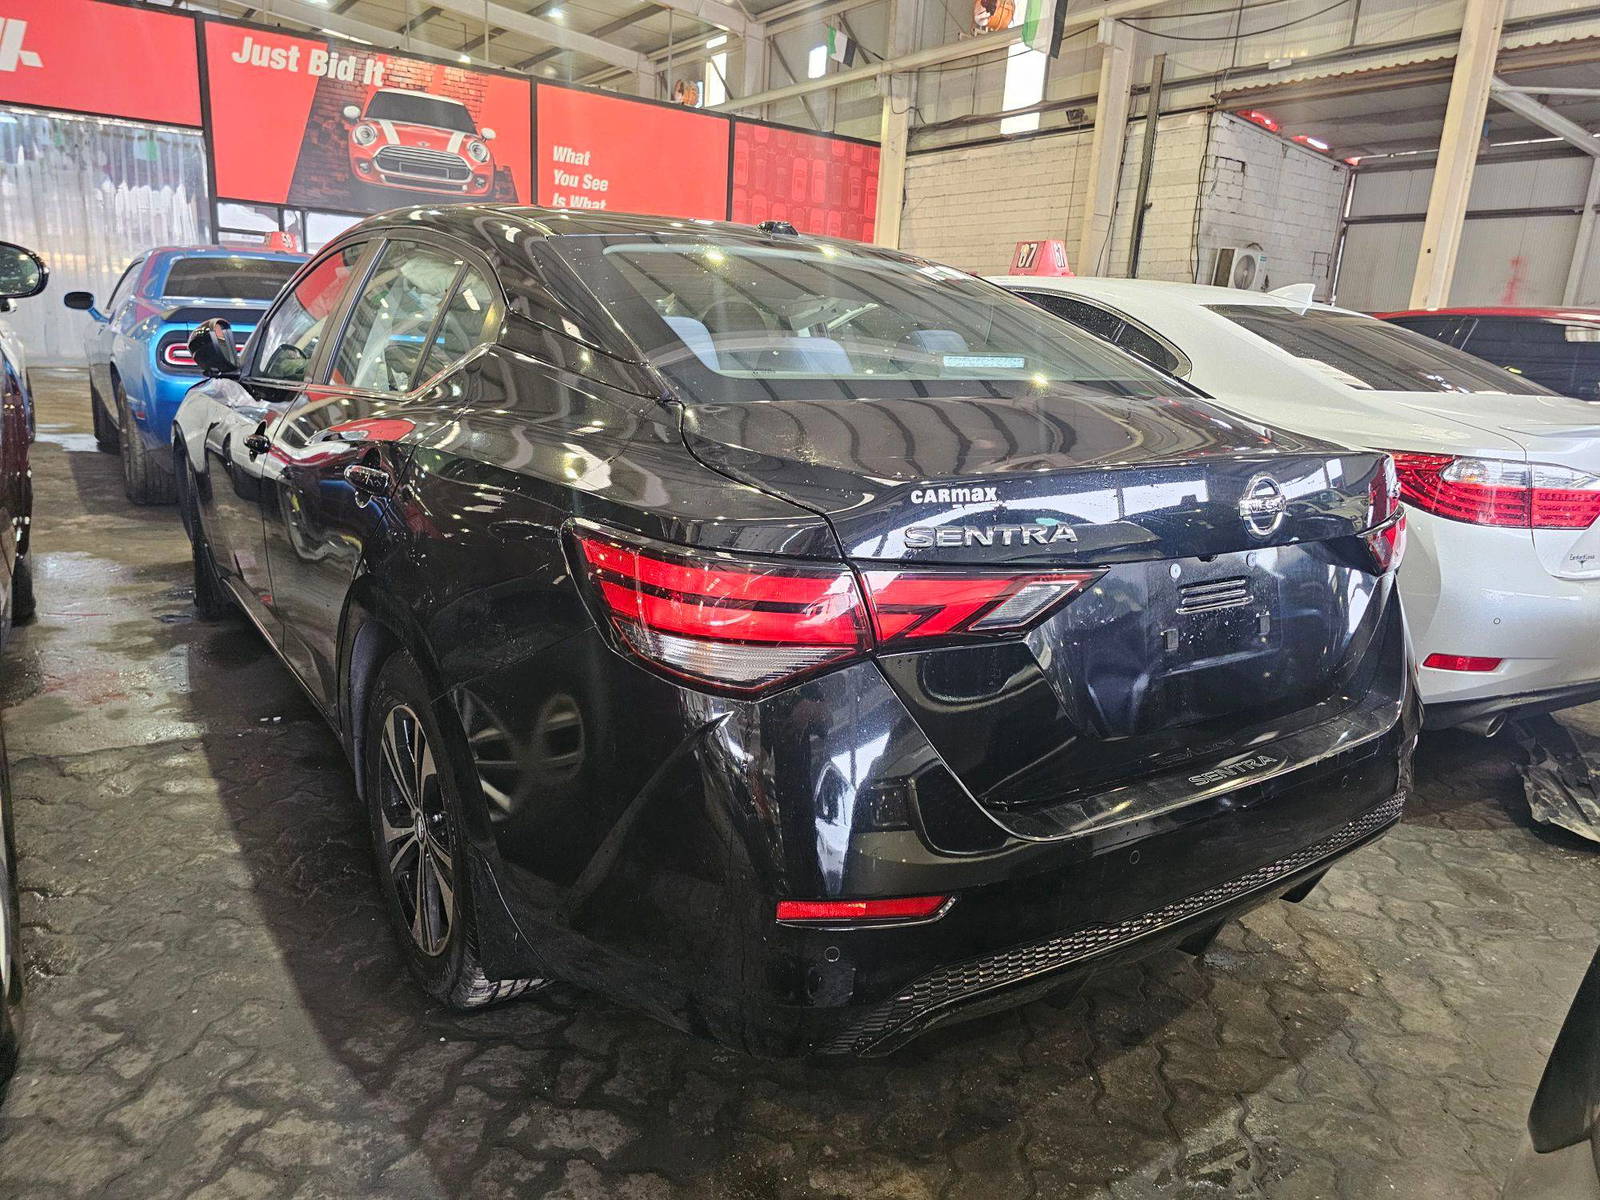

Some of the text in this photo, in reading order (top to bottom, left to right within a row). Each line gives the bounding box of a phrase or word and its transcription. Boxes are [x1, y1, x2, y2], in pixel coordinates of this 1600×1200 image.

[231, 36, 385, 87] Just Bid It
[553, 145, 591, 167] What
[553, 168, 609, 192] You See
[552, 192, 607, 209] Is What
[904, 523, 1079, 549] SENTRA
[1188, 755, 1279, 786] SENTRA
